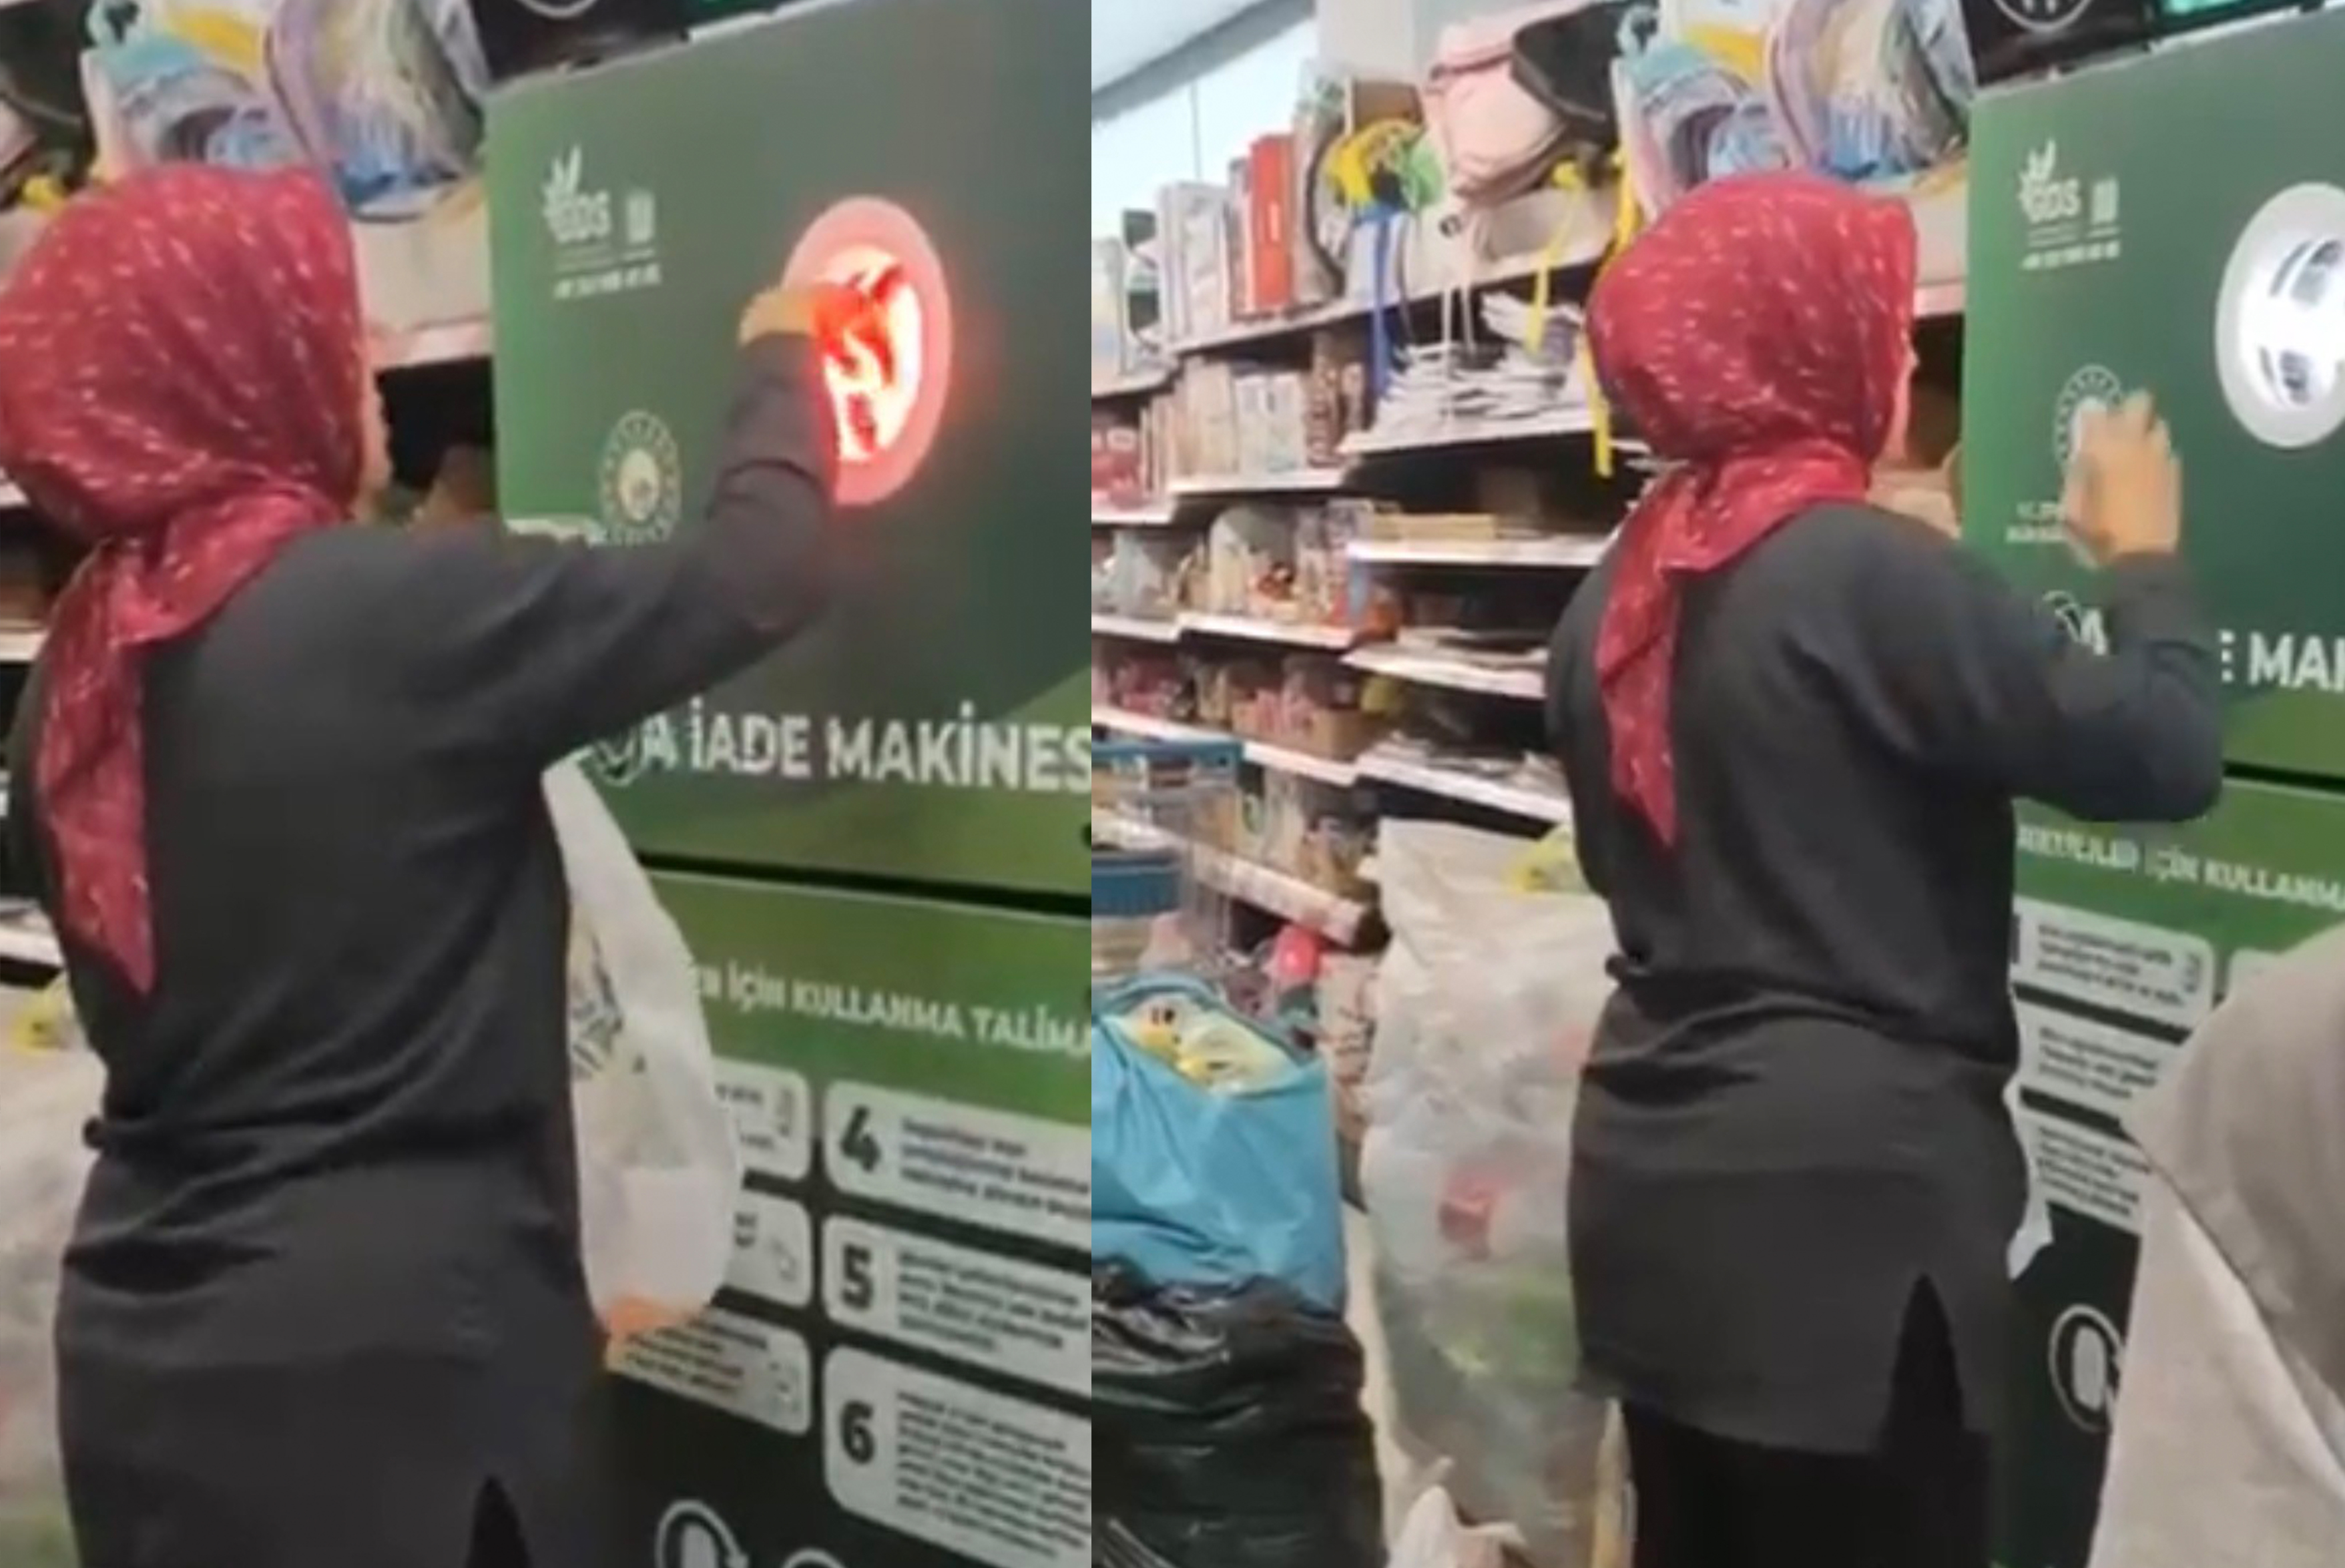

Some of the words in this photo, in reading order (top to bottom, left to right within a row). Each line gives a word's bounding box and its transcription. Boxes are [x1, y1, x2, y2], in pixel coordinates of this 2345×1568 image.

[688, 694, 810, 780] İADE
[840, 1105, 882, 1172] 4
[840, 1243, 876, 1310] 5
[839, 1400, 876, 1464] 6
